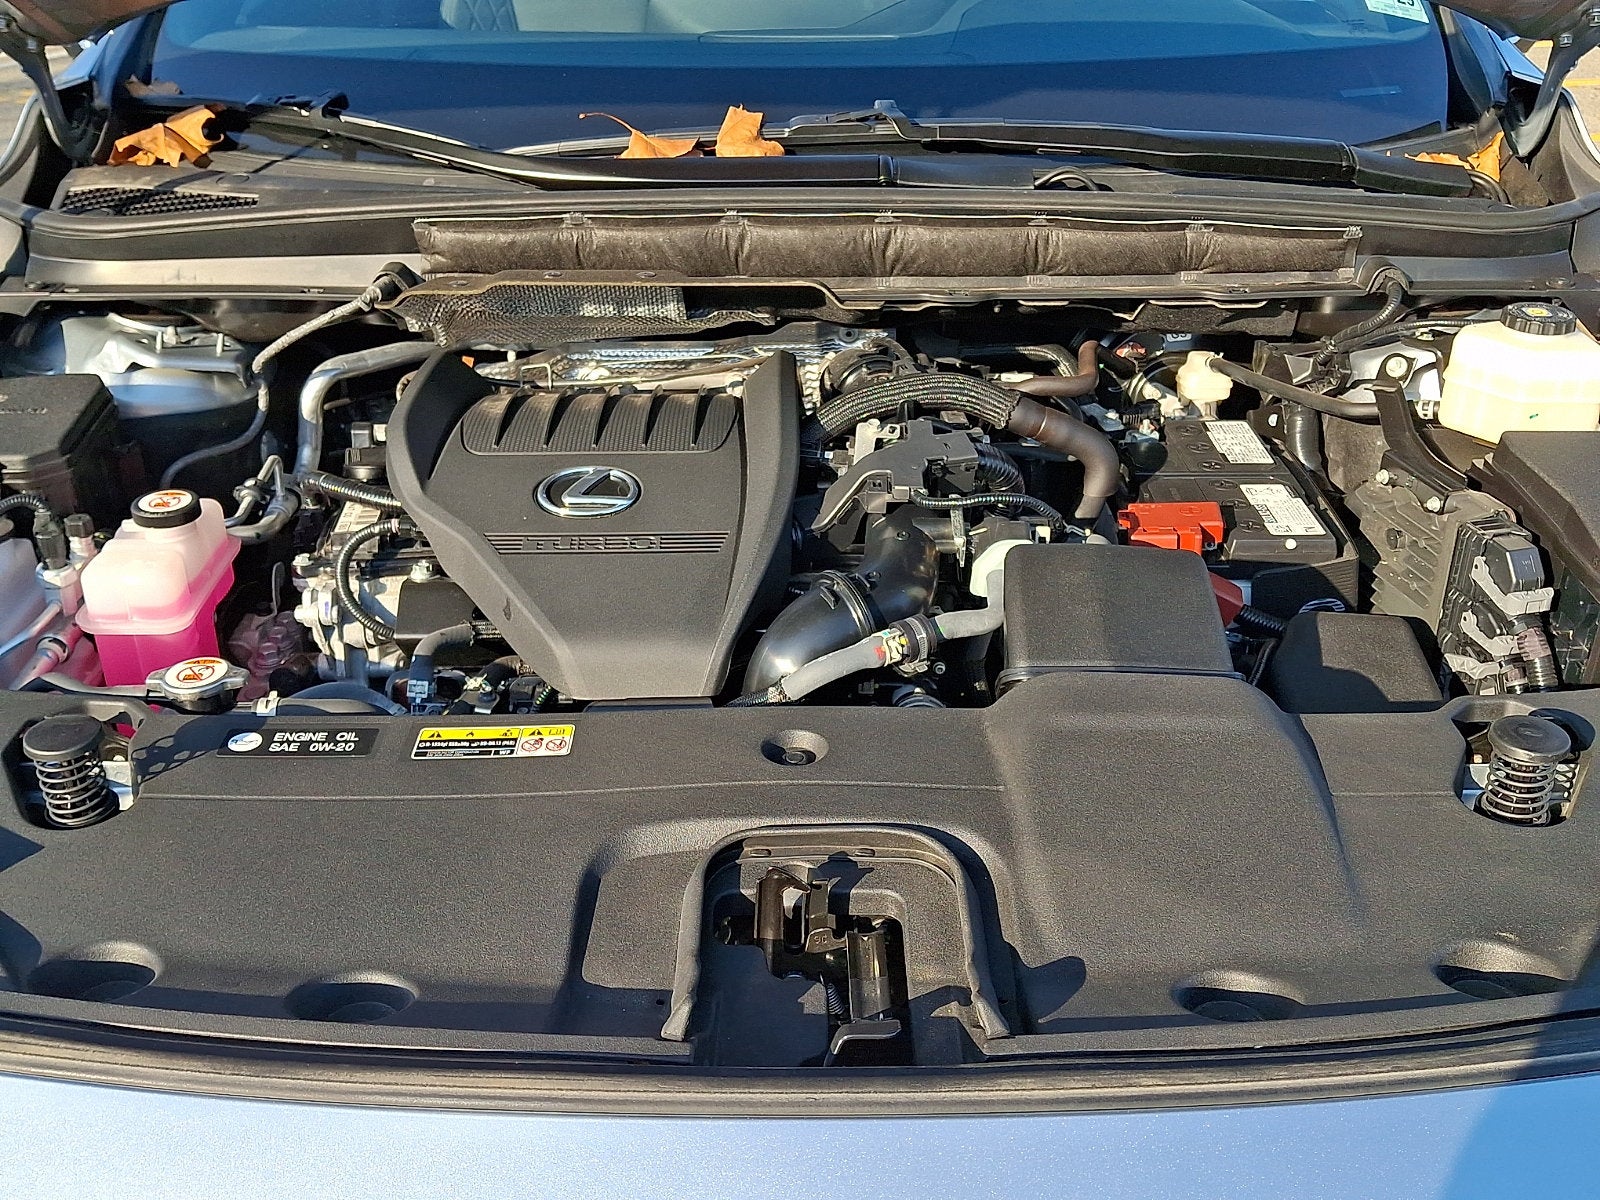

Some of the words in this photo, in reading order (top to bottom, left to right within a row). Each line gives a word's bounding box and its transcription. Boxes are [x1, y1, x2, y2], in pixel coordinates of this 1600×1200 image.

[526, 536, 657, 551] TURBO
[273, 732, 329, 742] ENGINE
[335, 732, 360, 742] OIL
[268, 742, 301, 752] SAE
[309, 742, 355, 752] 0W-20
